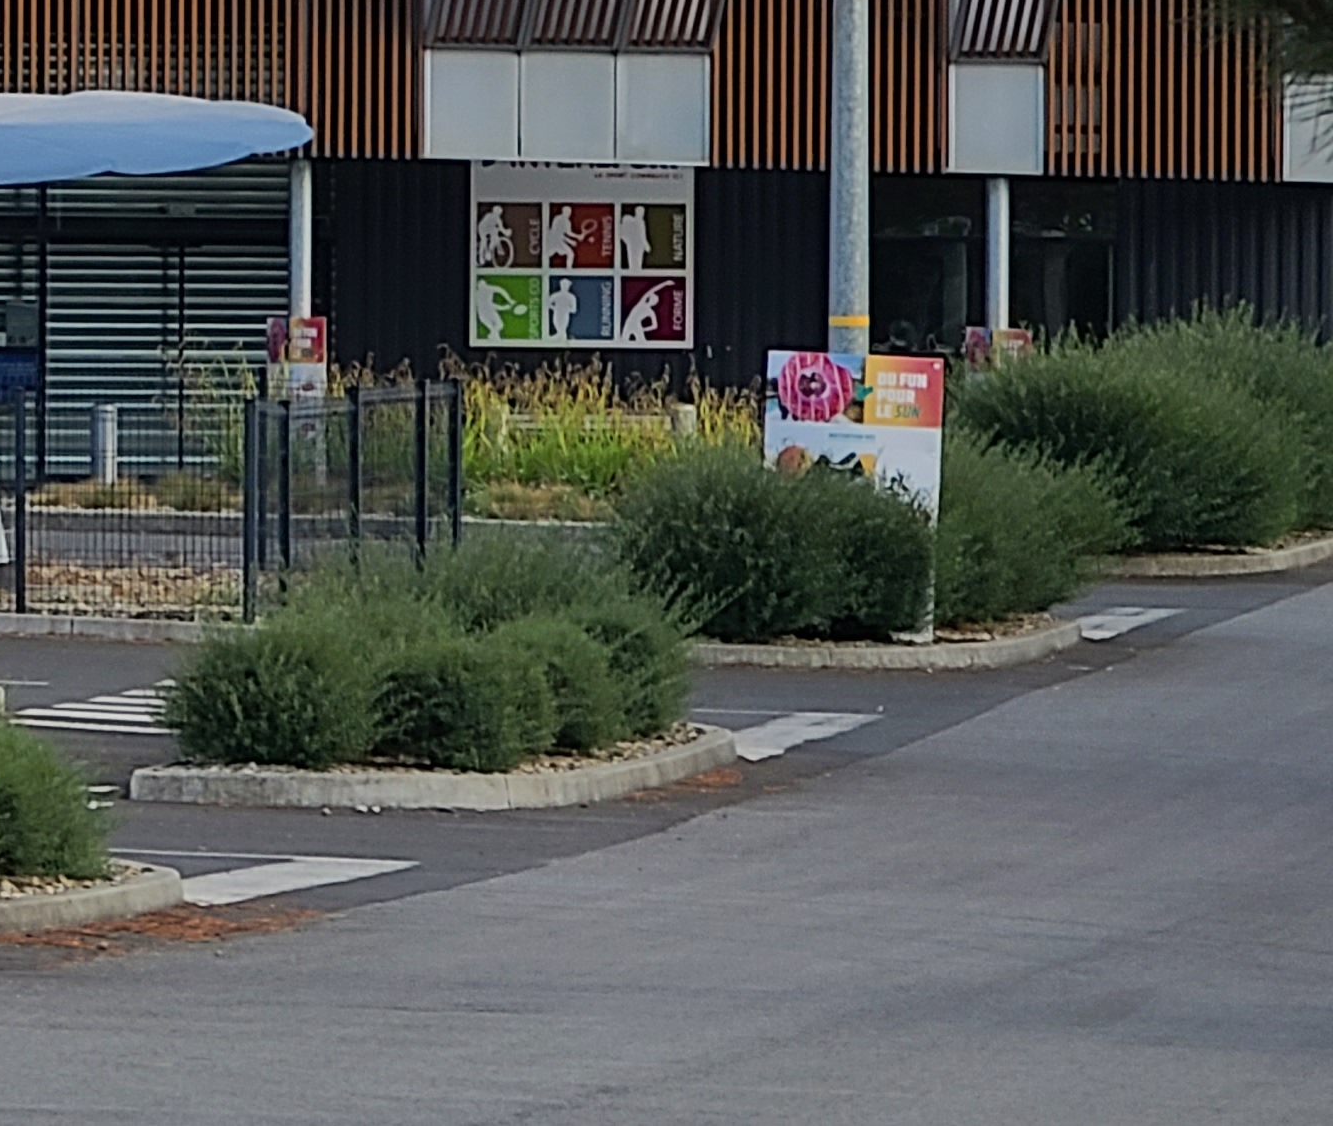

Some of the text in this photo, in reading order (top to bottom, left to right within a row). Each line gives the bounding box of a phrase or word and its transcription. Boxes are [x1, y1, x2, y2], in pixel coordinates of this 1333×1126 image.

[529, 219, 540, 255] CYCLE
[602, 216, 613, 257] TENNIS
[673, 214, 684, 262] NATURE
[601, 282, 612, 337] RUNNING
[673, 290, 684, 330] FORME
[899, 373, 928, 389] FUN
[876, 404, 921, 419] LE SUN
